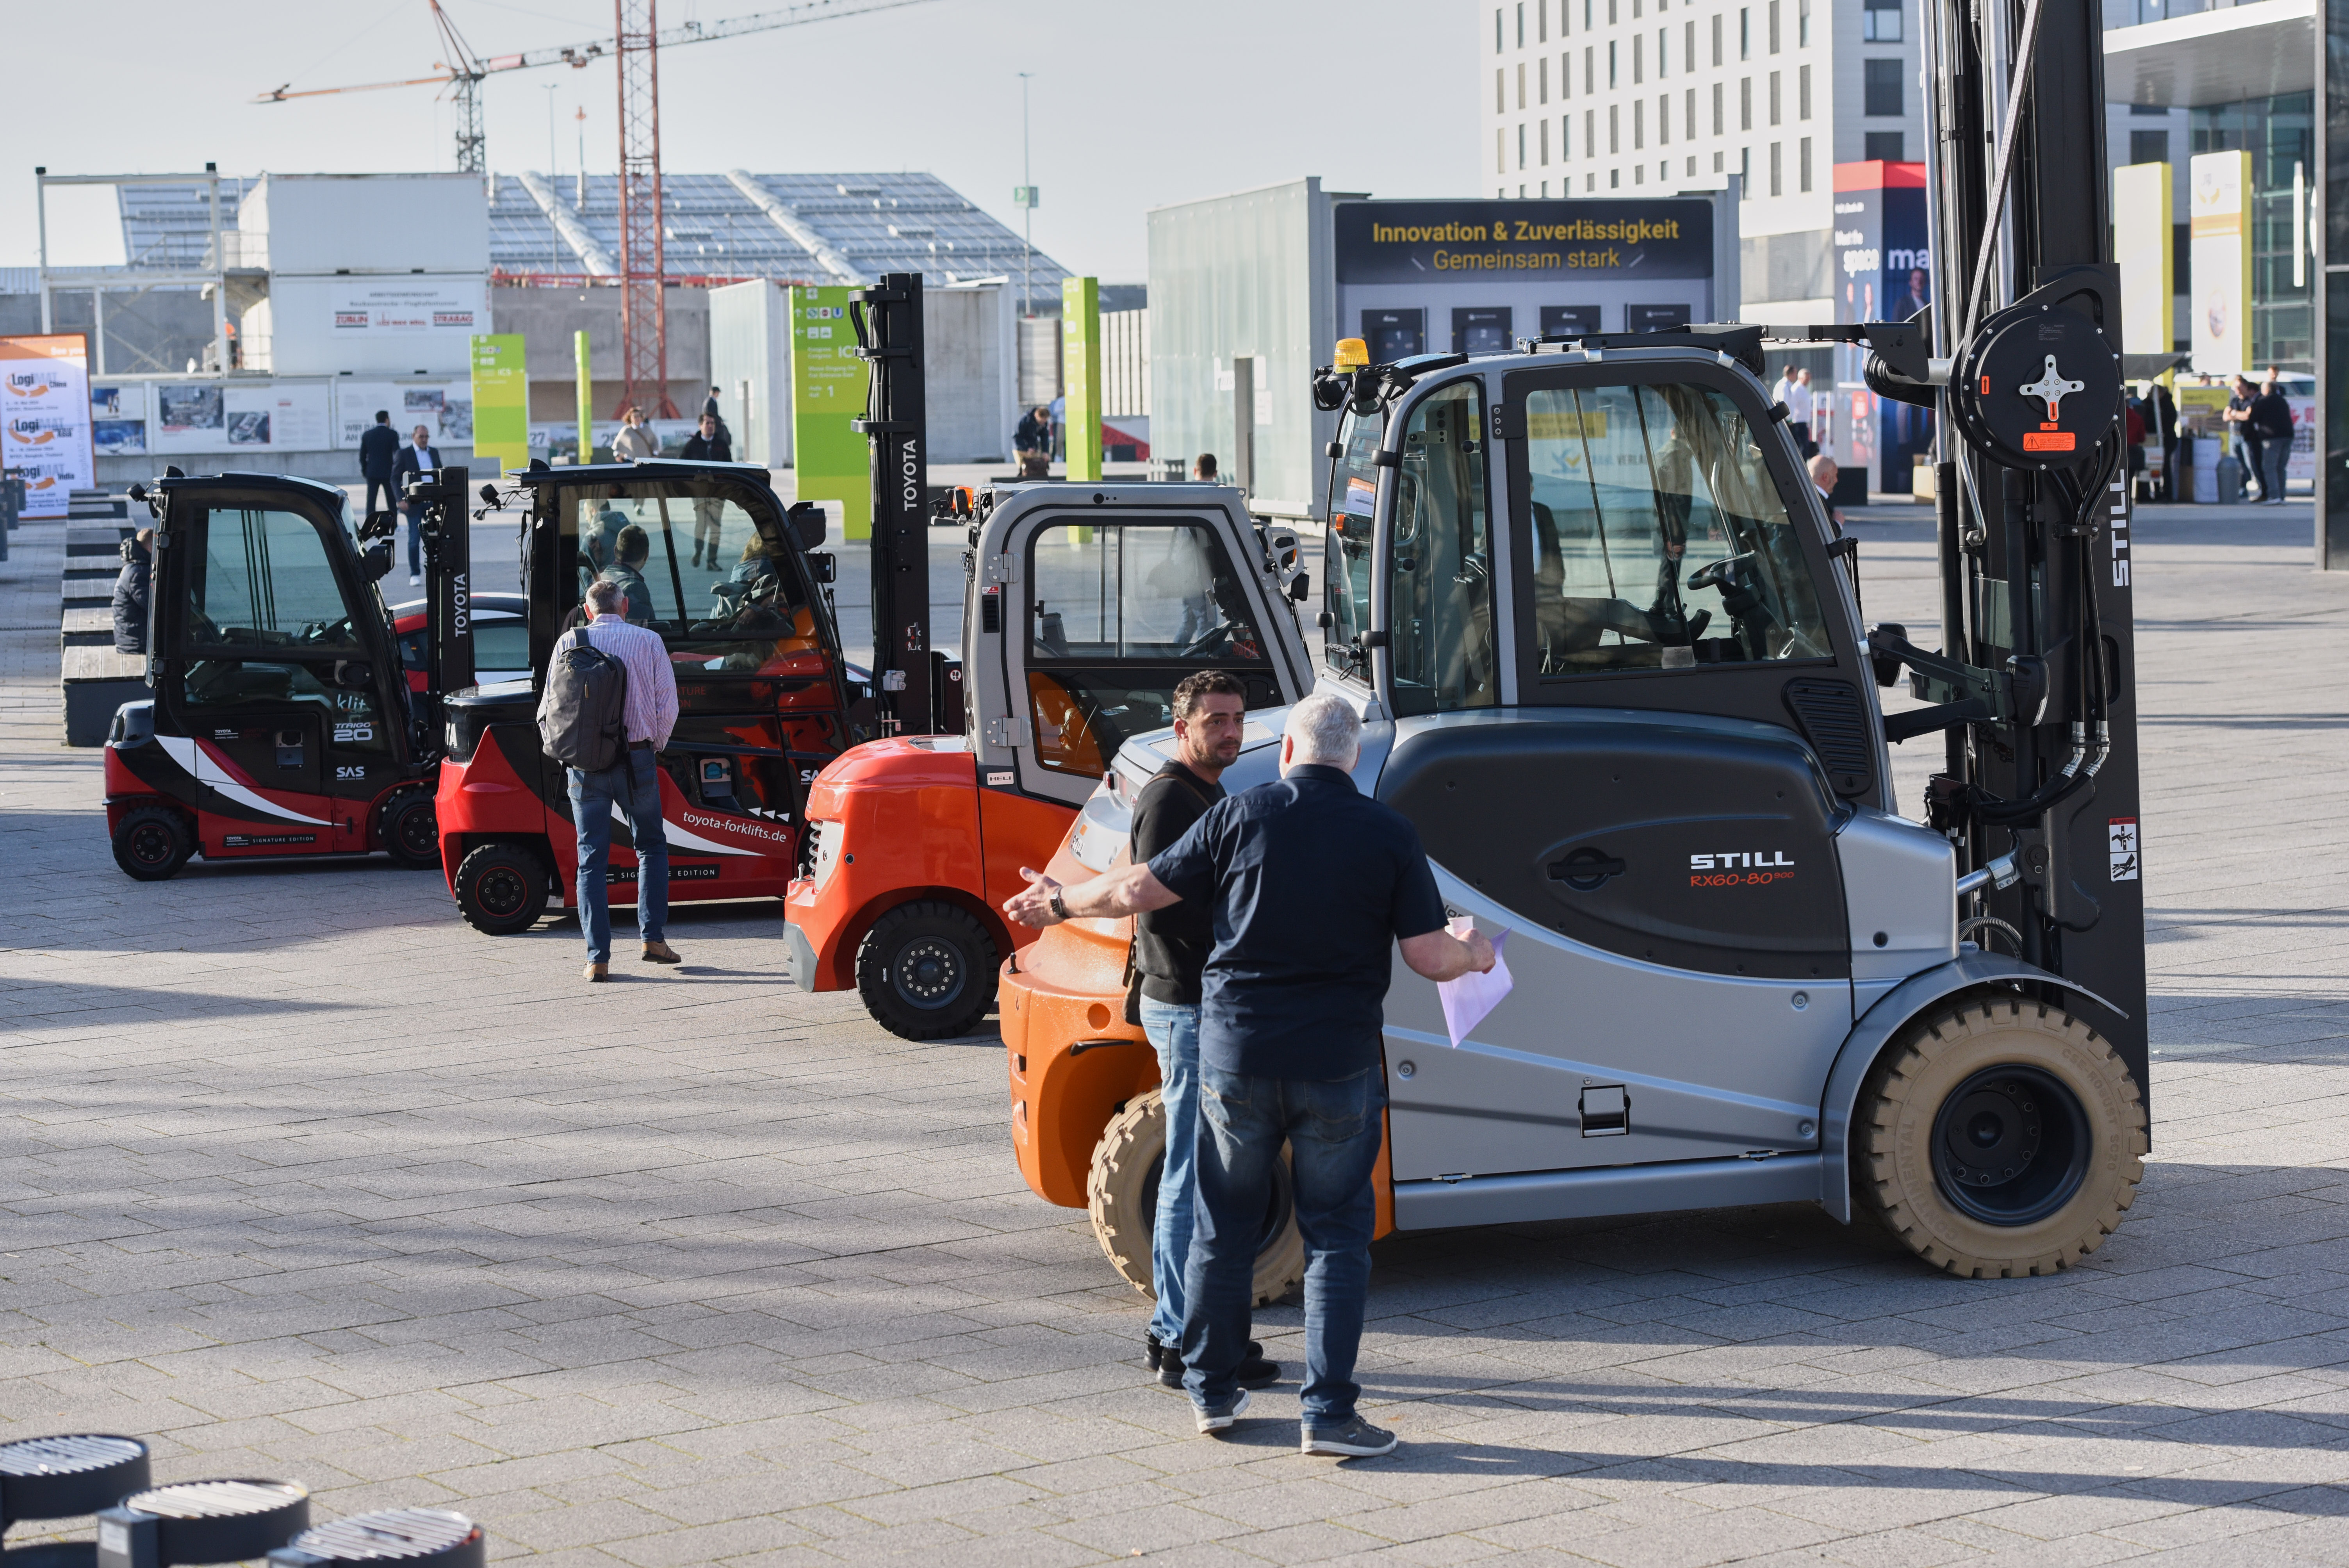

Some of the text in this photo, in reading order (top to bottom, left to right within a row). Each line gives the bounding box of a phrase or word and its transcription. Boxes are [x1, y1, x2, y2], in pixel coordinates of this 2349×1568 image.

[1373, 219, 1680, 244] Innovation & Zuverlässigkeit
[1433, 248, 1620, 270] Gemeinsam stark
[1844, 248, 1879, 278] space
[1888, 249, 1930, 270] ma
[433, 314, 473, 324] STRABAG
[51, 347, 67, 356] See
[49, 380, 67, 388] China
[827, 385, 834, 397] 1
[903, 439, 917, 511] TOYOTA
[2110, 469, 2129, 587] STILL
[454, 573, 466, 638] TOYOTA
[334, 729, 373, 742] 20
[446, 722, 457, 747] TA
[337, 766, 365, 777] SAS
[801, 770, 820, 781] SA
[683, 812, 786, 843] toyota-forklifts.de
[1691, 851, 1795, 869] STILL
